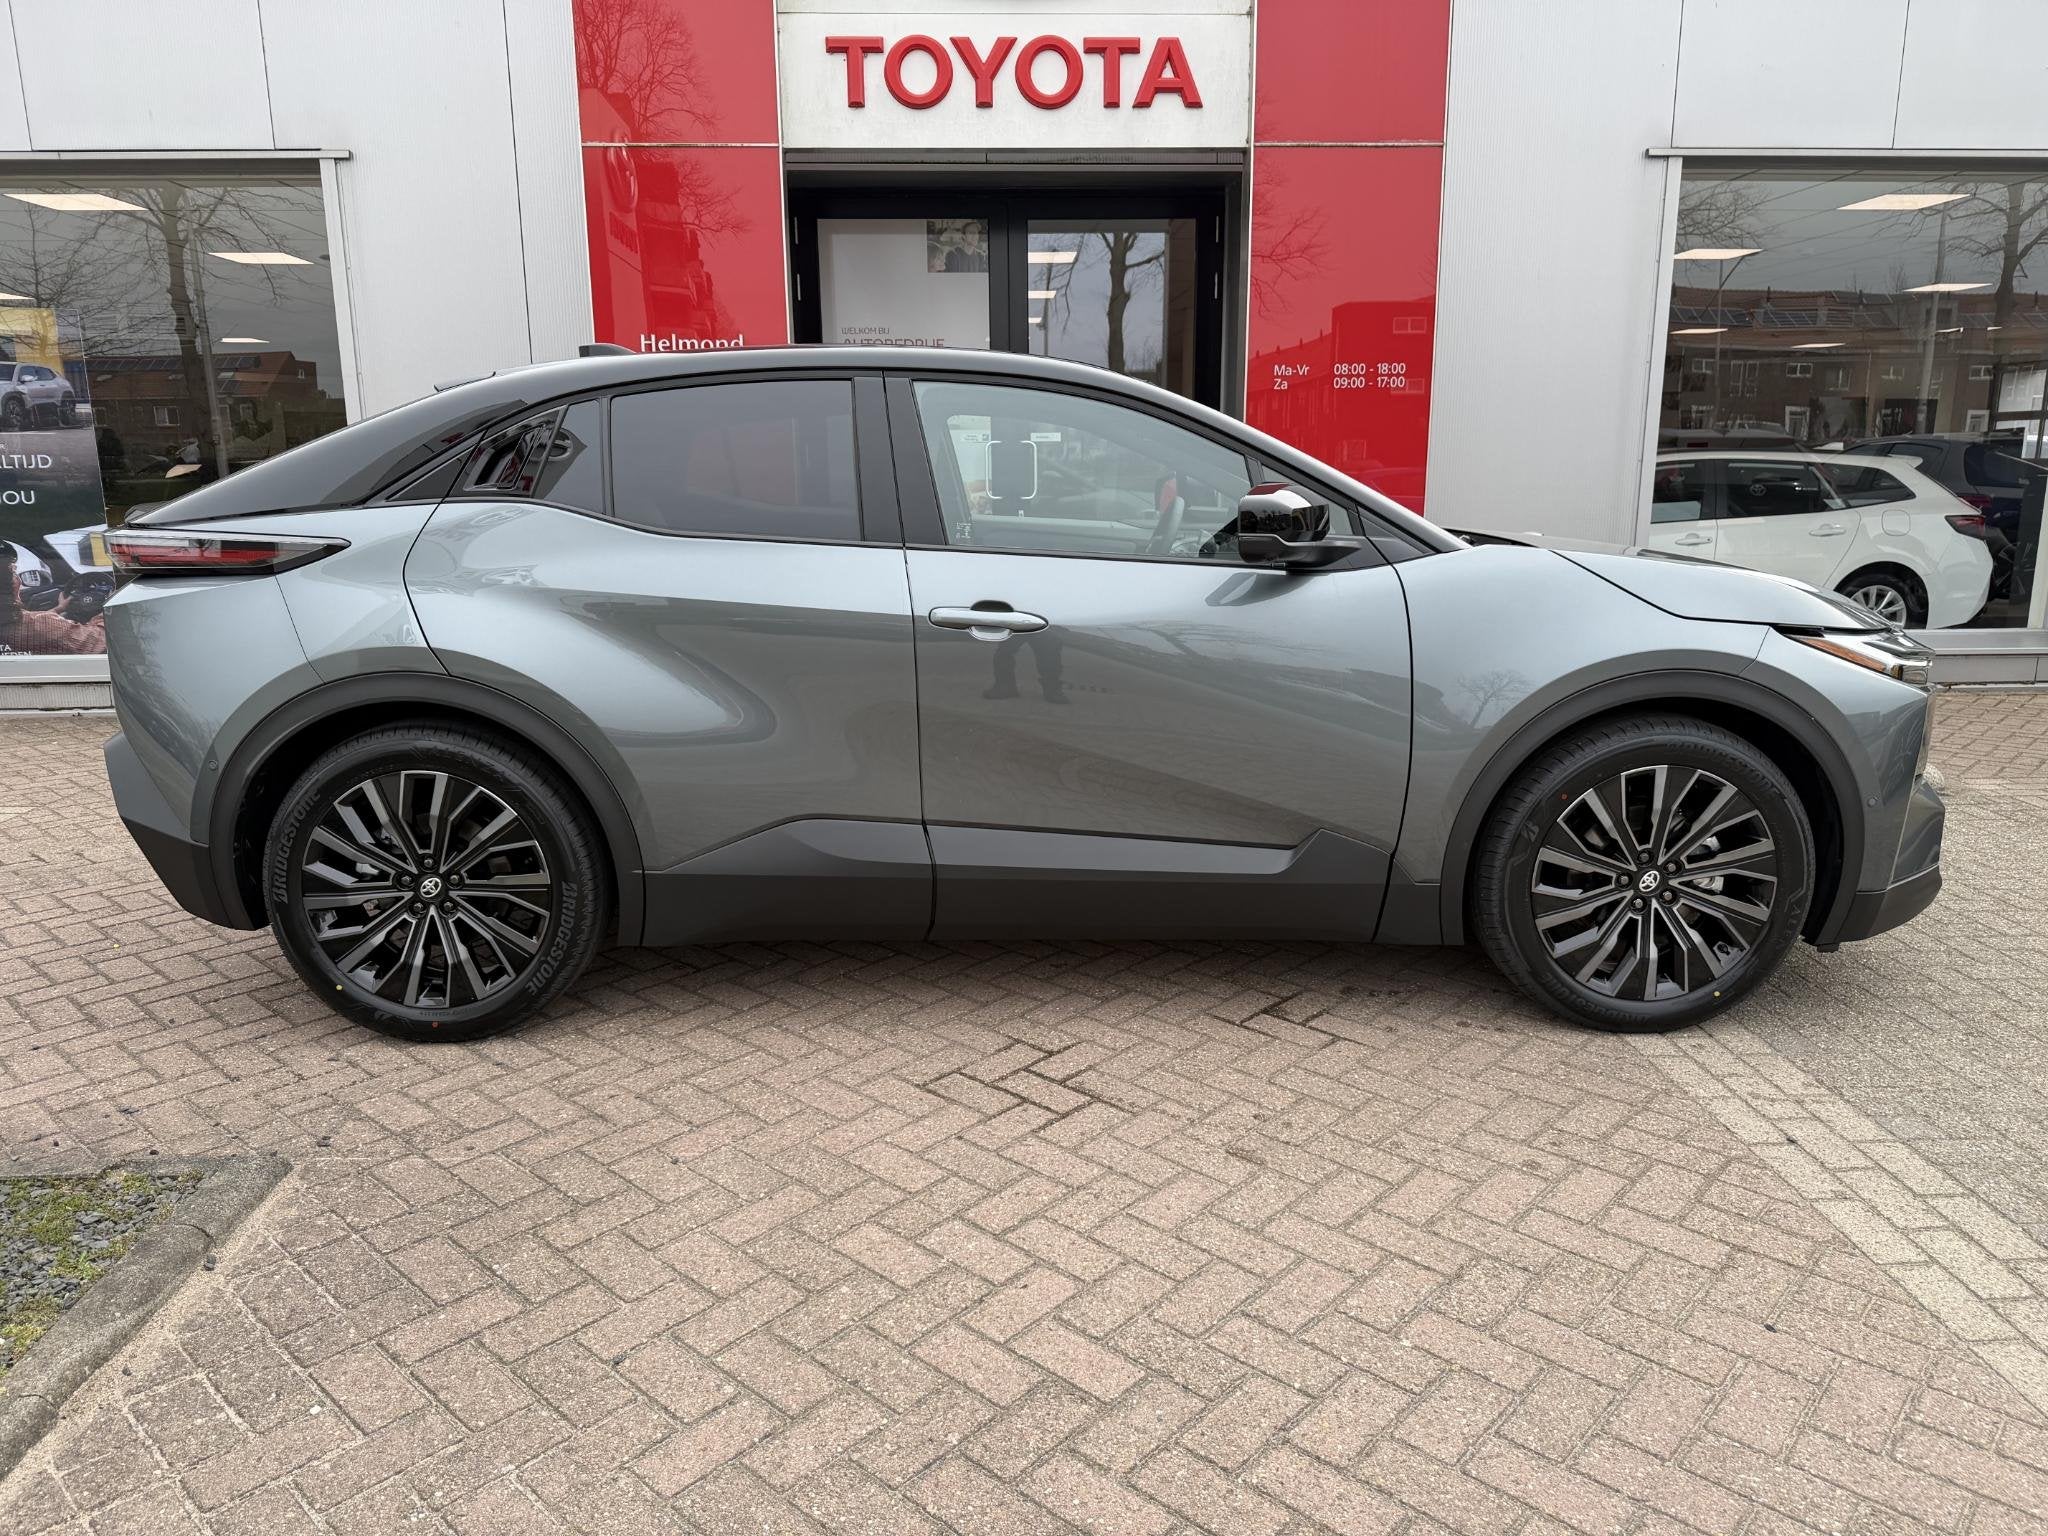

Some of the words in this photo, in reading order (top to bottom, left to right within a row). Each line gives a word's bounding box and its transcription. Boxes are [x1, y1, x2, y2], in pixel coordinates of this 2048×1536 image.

[825, 34, 1203, 109] TOYOTA
[841, 327, 877, 335] WELKOM
[878, 327, 890, 335] BIJ
[640, 334, 743, 352] Helmond
[1273, 364, 1310, 376] Ma-Vr
[1333, 363, 1366, 375] 08:00
[1376, 362, 1406, 374] 18:00
[1273, 378, 1288, 390] Za
[1333, 377, 1365, 389] 09:00
[1376, 376, 1405, 388] 17:00
[0, 454, 52, 469] LTIJD
[0, 490, 35, 505] OU
[271, 787, 321, 905] BRIDGESTONE
[525, 880, 578, 996] BRIDGESTONE
